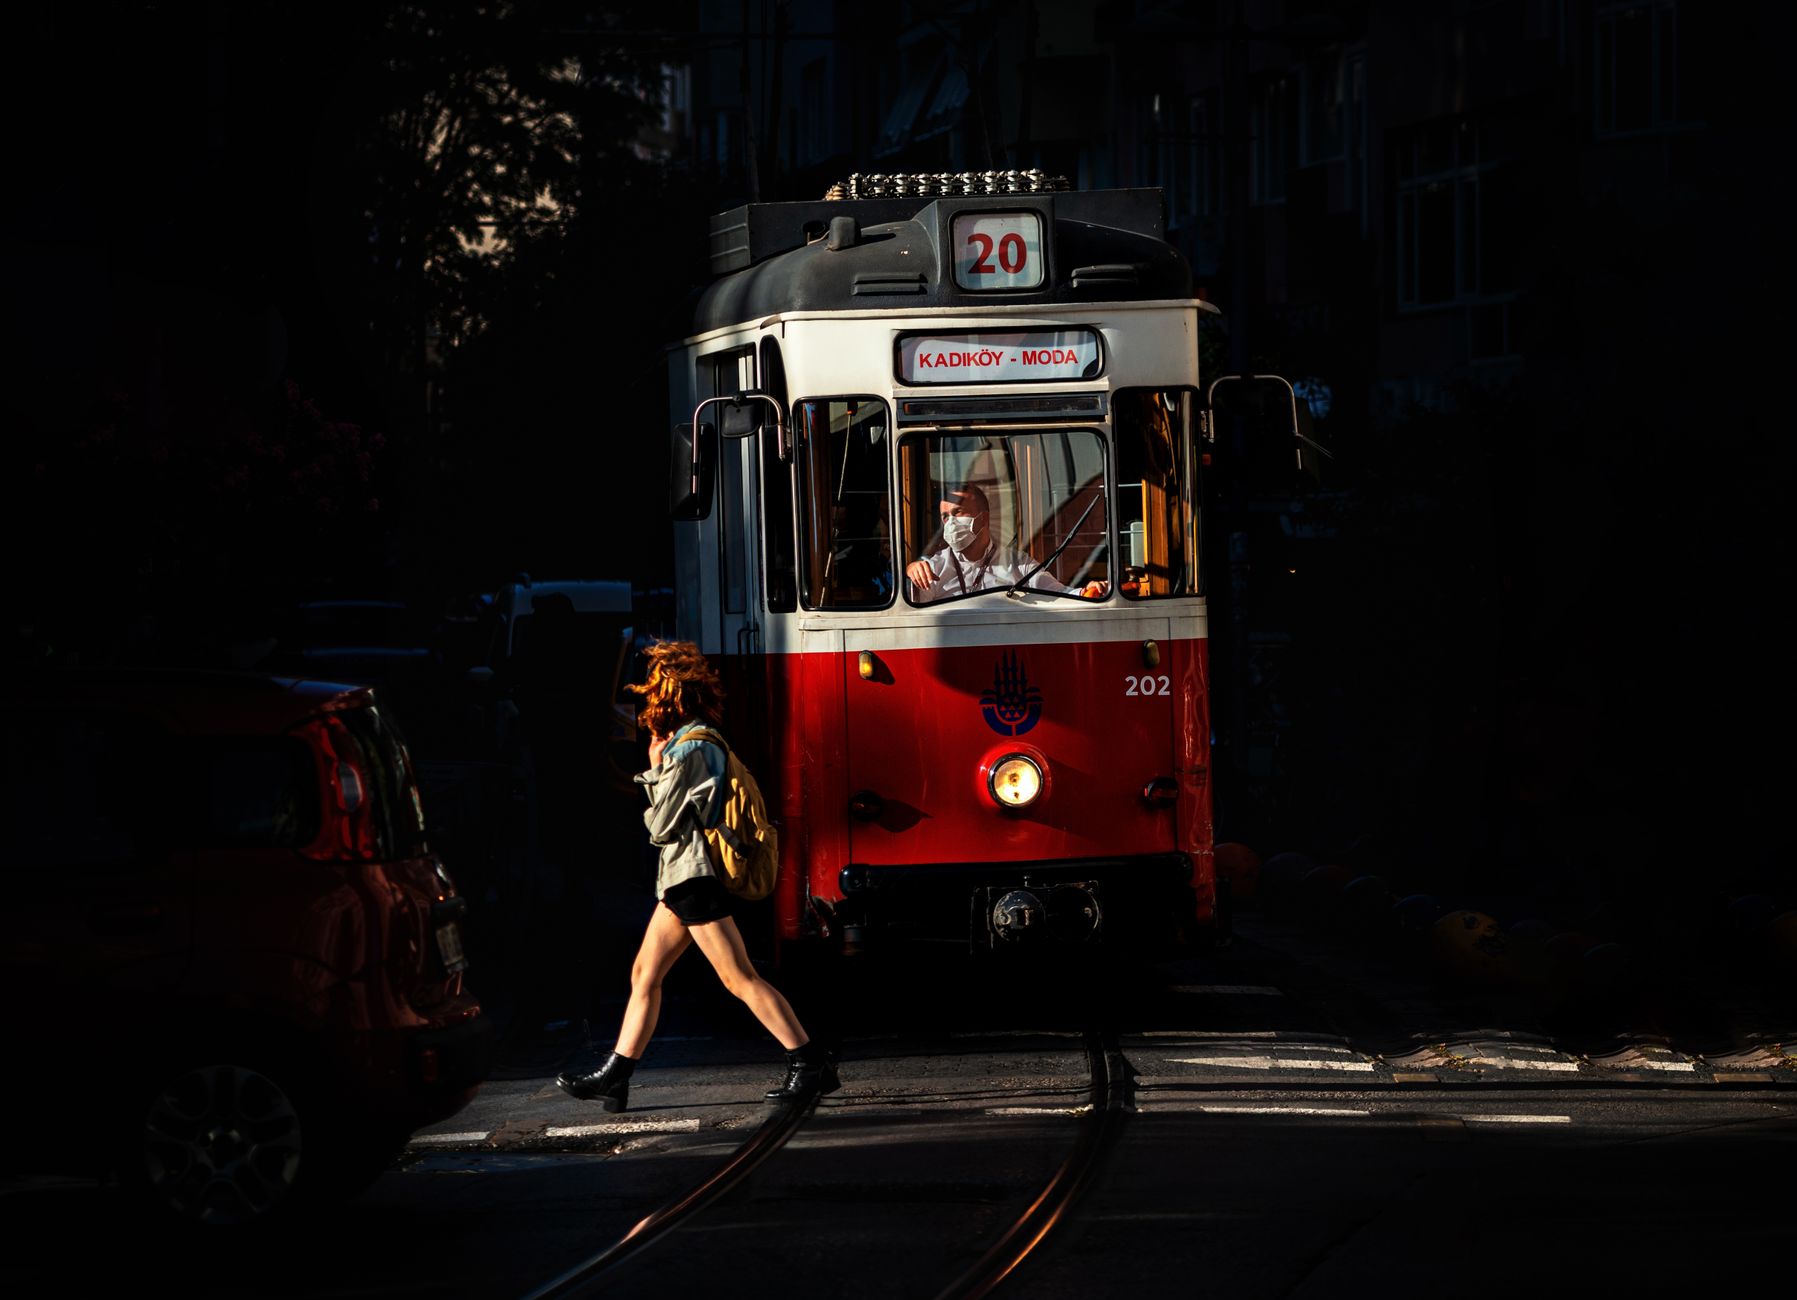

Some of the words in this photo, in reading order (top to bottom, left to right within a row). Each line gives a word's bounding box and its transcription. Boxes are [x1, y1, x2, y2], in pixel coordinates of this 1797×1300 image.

[967, 232, 1027, 274] 20
[919, 349, 1003, 368] KADIKÖY
[1022, 349, 1078, 366] MODA
[1125, 675, 1171, 696] 202
